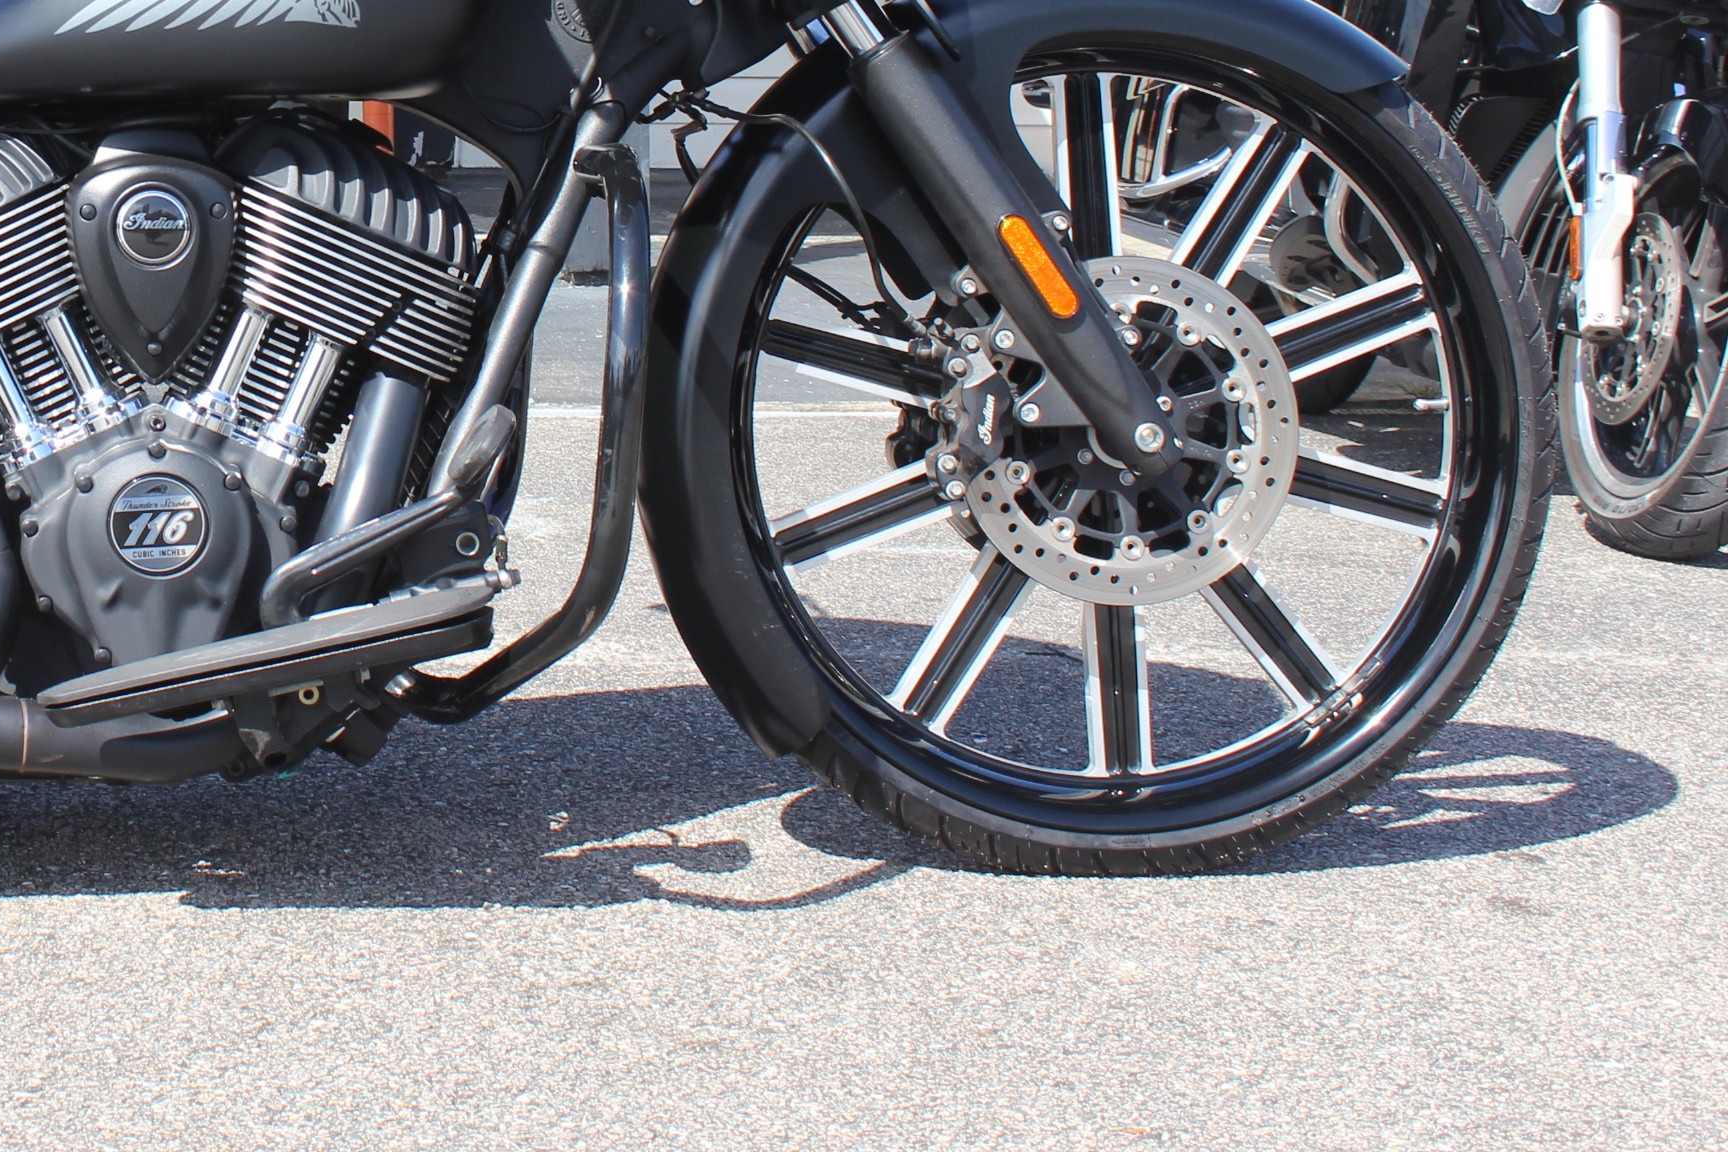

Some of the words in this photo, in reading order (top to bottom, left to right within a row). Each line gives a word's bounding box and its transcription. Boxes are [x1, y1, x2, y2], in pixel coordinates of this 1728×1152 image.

[123, 212, 184, 231] Indian
[977, 393, 995, 445] Indian
[122, 499, 158, 510] Thunder
[160, 497, 191, 508] Stroke
[123, 510, 194, 546] 116
[132, 550, 154, 558] CUBIC
[159, 548, 186, 557] INCHES
